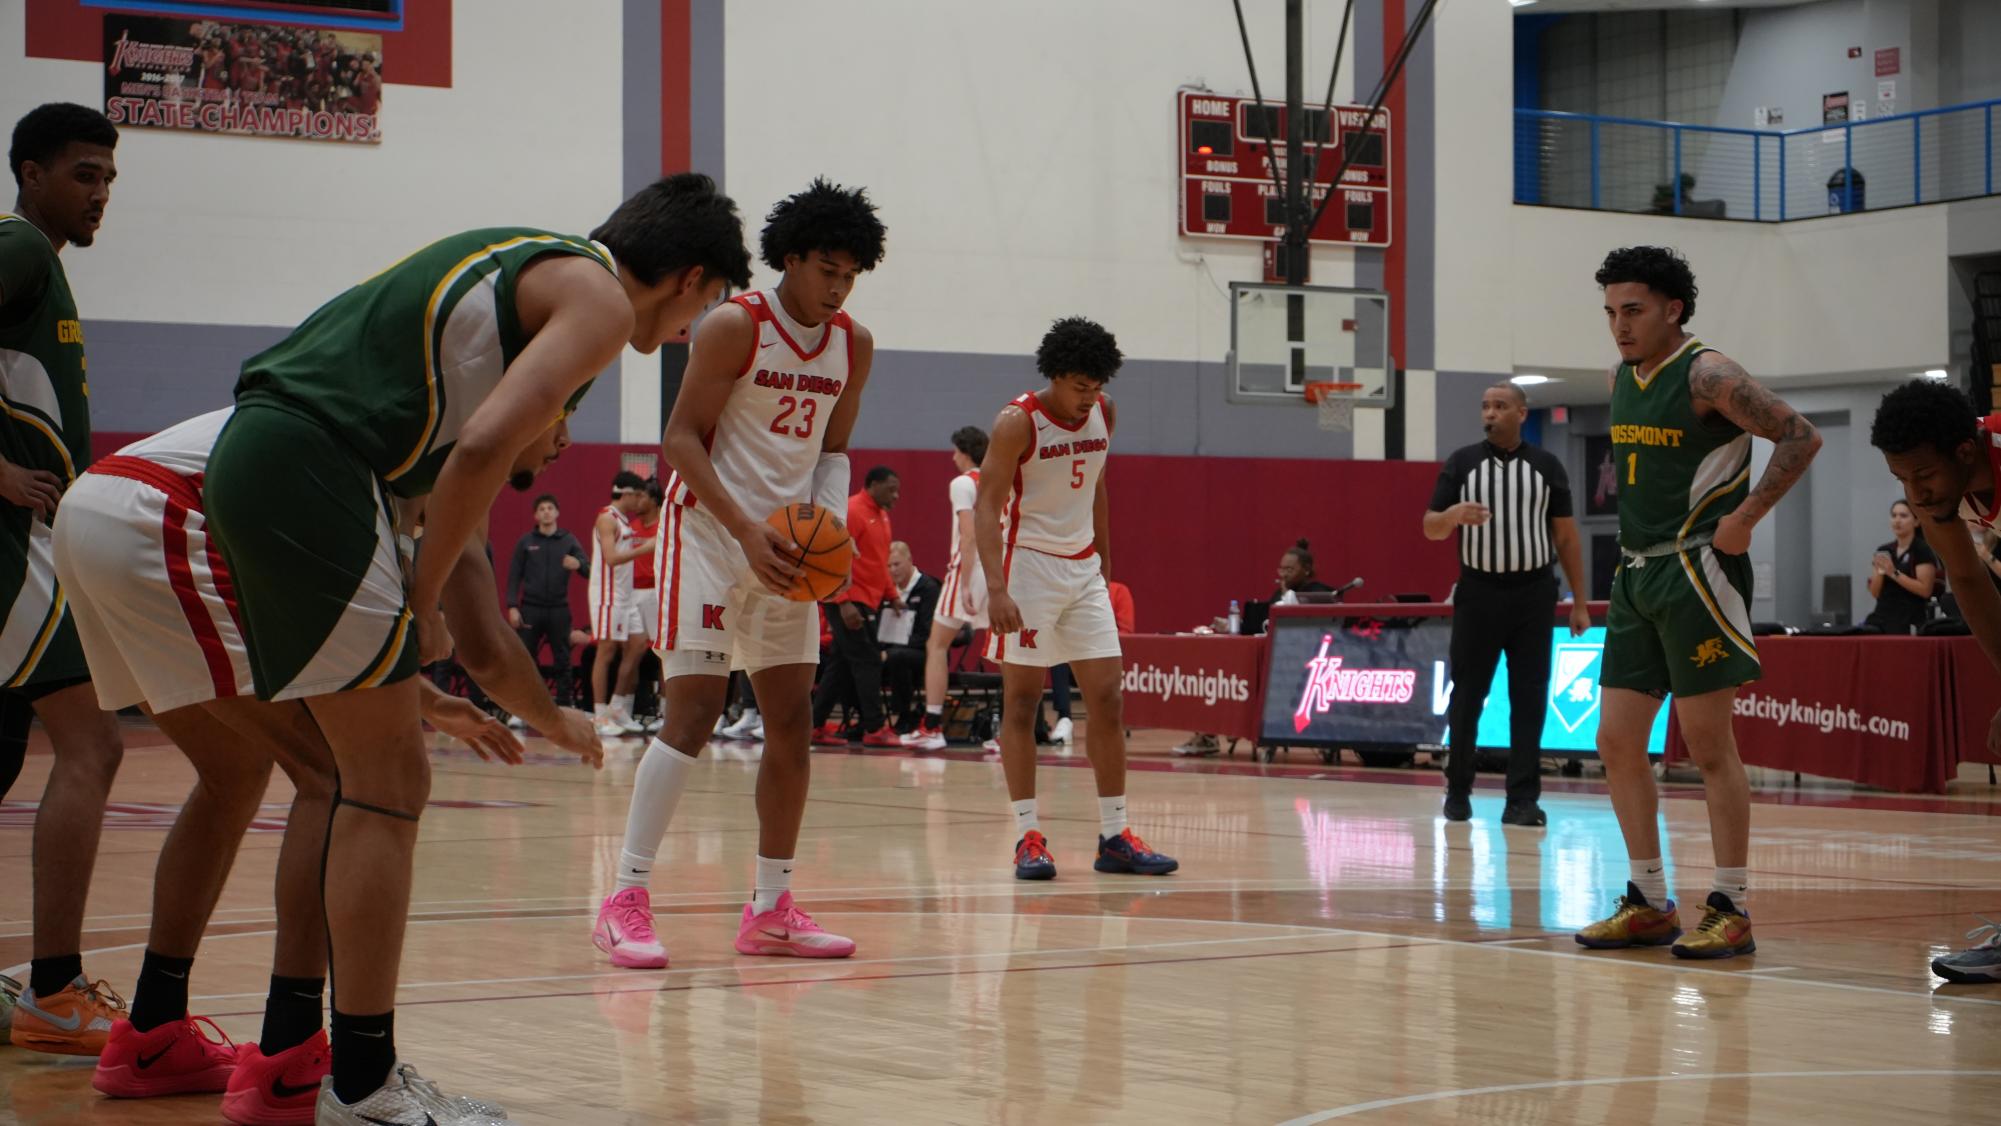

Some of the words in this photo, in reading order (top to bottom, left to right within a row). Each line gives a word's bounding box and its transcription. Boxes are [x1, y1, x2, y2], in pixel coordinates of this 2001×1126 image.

[106, 96, 195, 127] STATE
[200, 102, 380, 139] CHAMPIONS!
[1192, 99, 1230, 116] HOME
[1206, 160, 1238, 173] BONUS
[1341, 169, 1369, 182] ONUS
[1201, 180, 1232, 194] FOULS
[1345, 190, 1373, 203] FOULS
[754, 369, 794, 391] SAN
[796, 374, 842, 397] DIEGO
[769, 395, 817, 438] 23
[1611, 424, 1683, 447] OSSMONT
[1040, 443, 1070, 459] SAN
[1072, 438, 1107, 455] DIEGO
[1070, 459, 1086, 489] 5
[1626, 452, 1638, 485] 1
[702, 604, 725, 631] K
[1019, 628, 1038, 649] K
[1294, 634, 1416, 733] KNIGHTS
